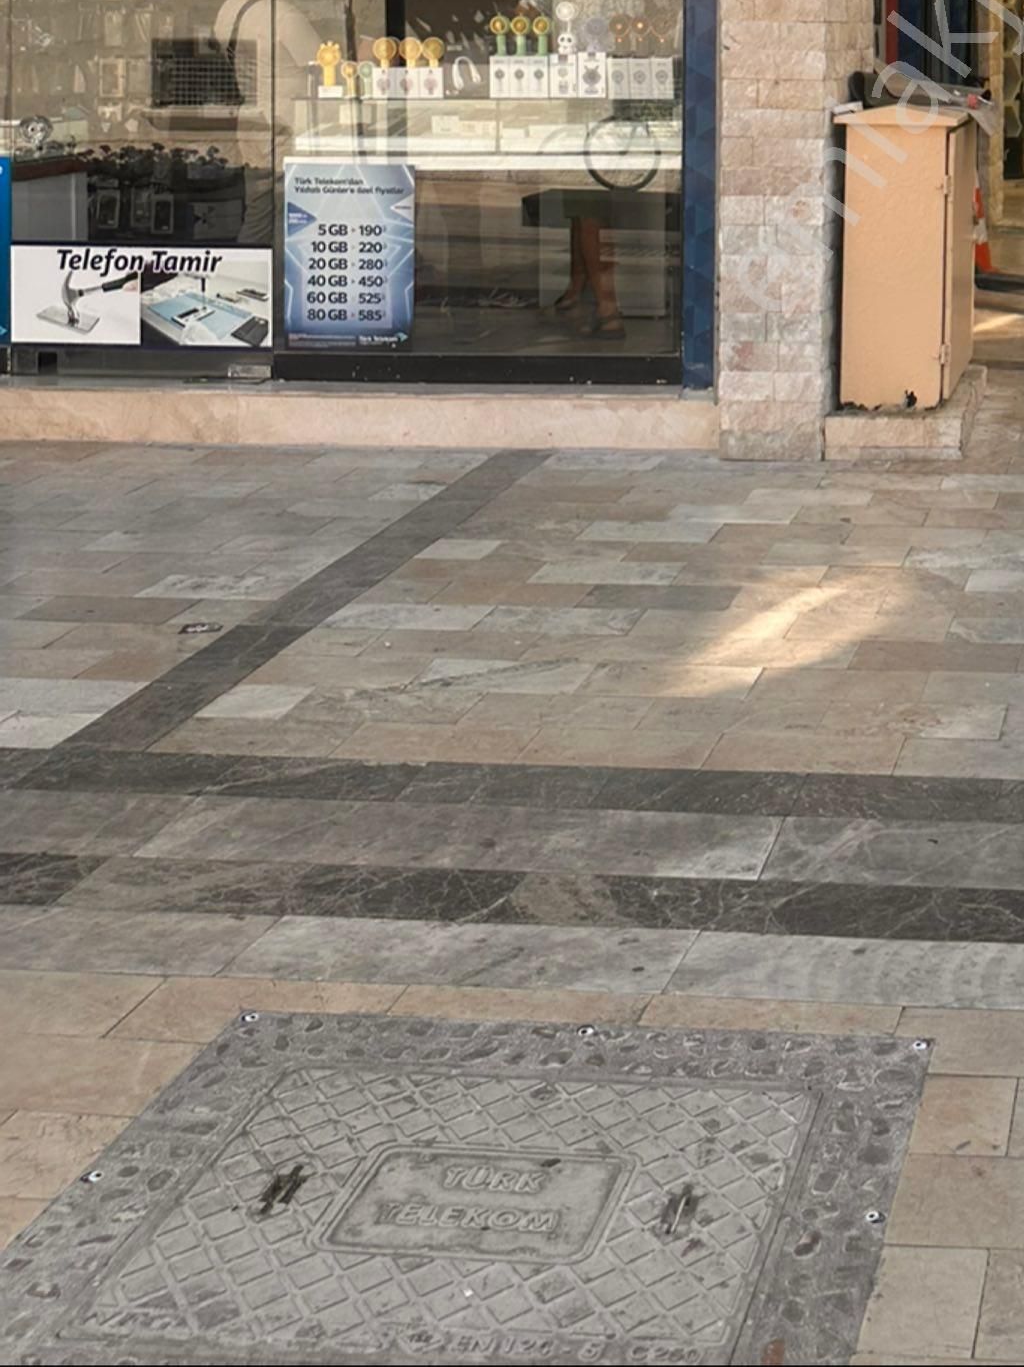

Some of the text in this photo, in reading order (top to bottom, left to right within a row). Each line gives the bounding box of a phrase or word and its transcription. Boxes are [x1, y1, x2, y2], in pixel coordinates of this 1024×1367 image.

[318, 224, 326, 236] 5
[328, 224, 348, 236] GB
[311, 241, 326, 253] 10
[328, 241, 348, 253] GB
[57, 248, 222, 277] Telefon Tamir
[308, 258, 326, 270] 20
[328, 258, 348, 270] GB
[307, 275, 326, 287] 40
[328, 275, 348, 287] GB
[307, 292, 326, 304] 60
[328, 292, 348, 304] GB
[307, 308, 326, 320] 80
[328, 308, 348, 320] GB
[444, 1165, 547, 1194] TÜRK
[375, 1202, 558, 1232] TELEKOM
